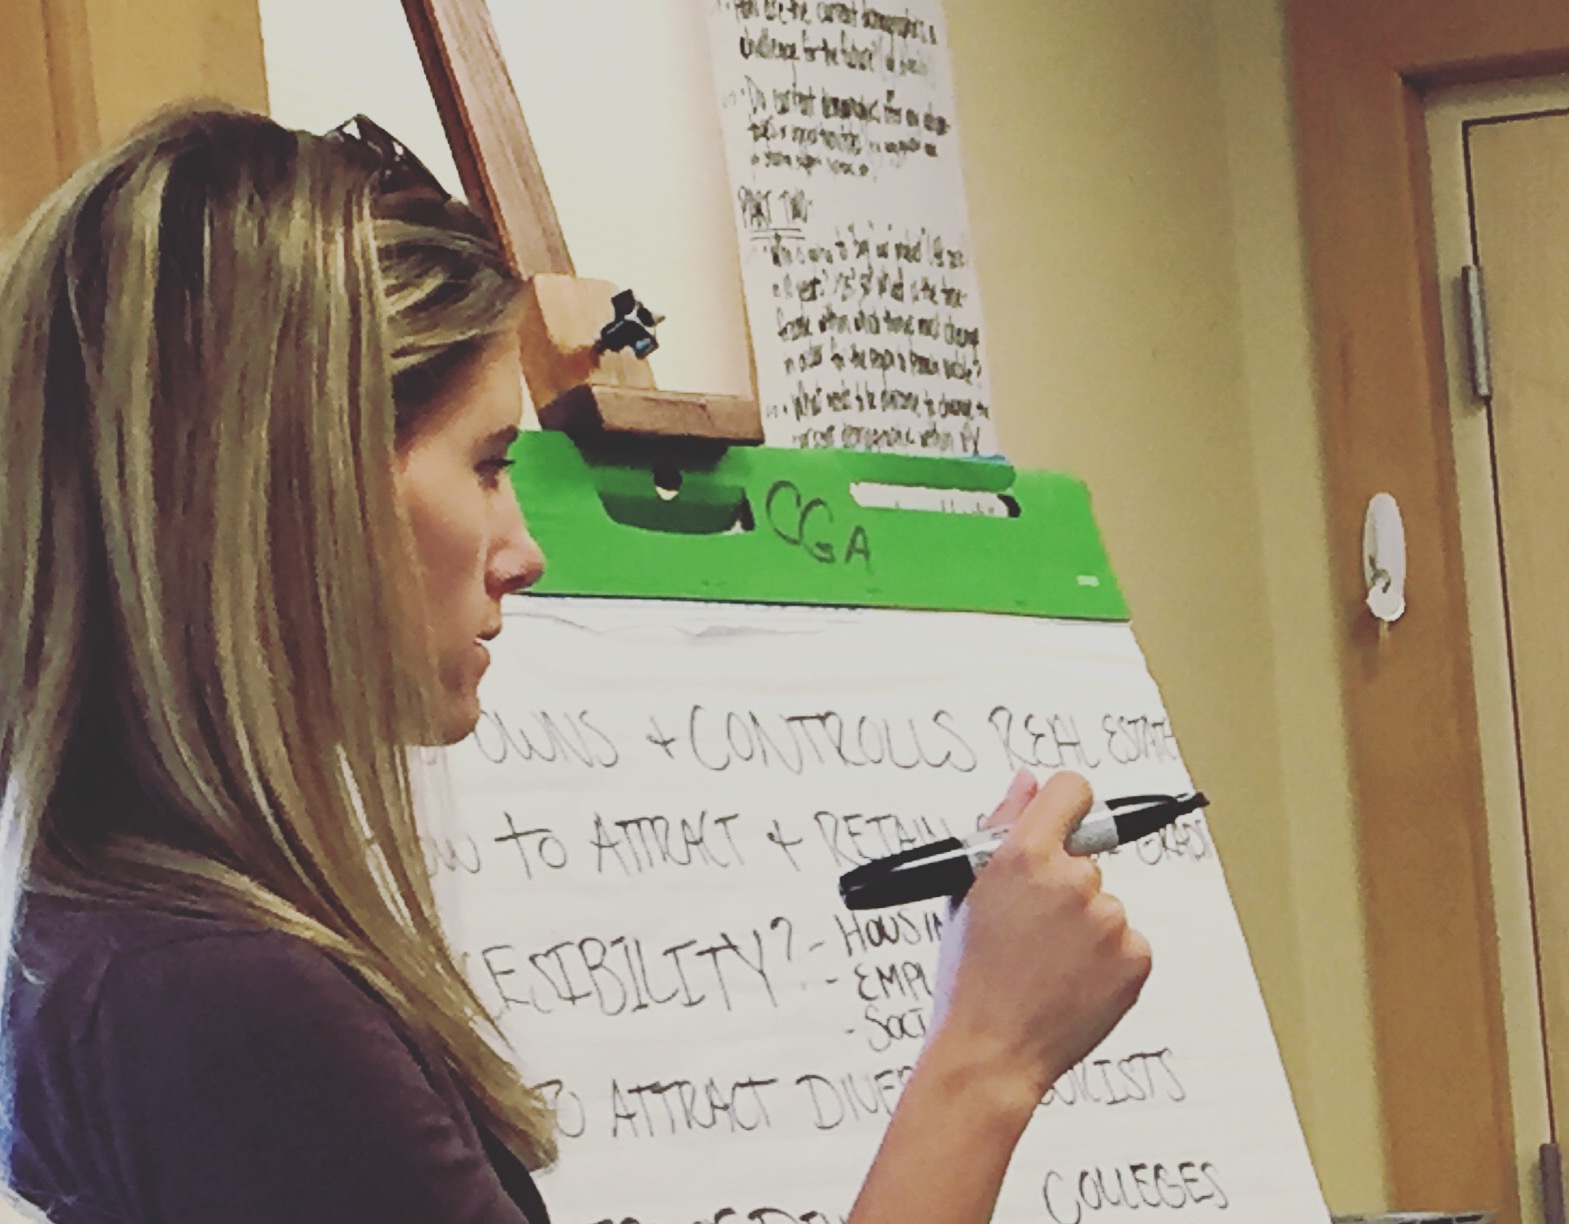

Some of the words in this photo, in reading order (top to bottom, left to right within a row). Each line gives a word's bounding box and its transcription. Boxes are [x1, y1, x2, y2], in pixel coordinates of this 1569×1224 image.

[475, 708, 619, 769] OWNS
[689, 703, 979, 775] CONTROLLS
[988, 705, 1101, 770] REAL
[590, 810, 745, 877] ATTRACT
[481, 916, 808, 1018] ESIBILITY?
[833, 911, 944, 958] HOUSIN
[853, 960, 935, 1001] EMPL
[864, 1003, 927, 1052] SOCI
[611, 1076, 779, 1138] ATTRACT
